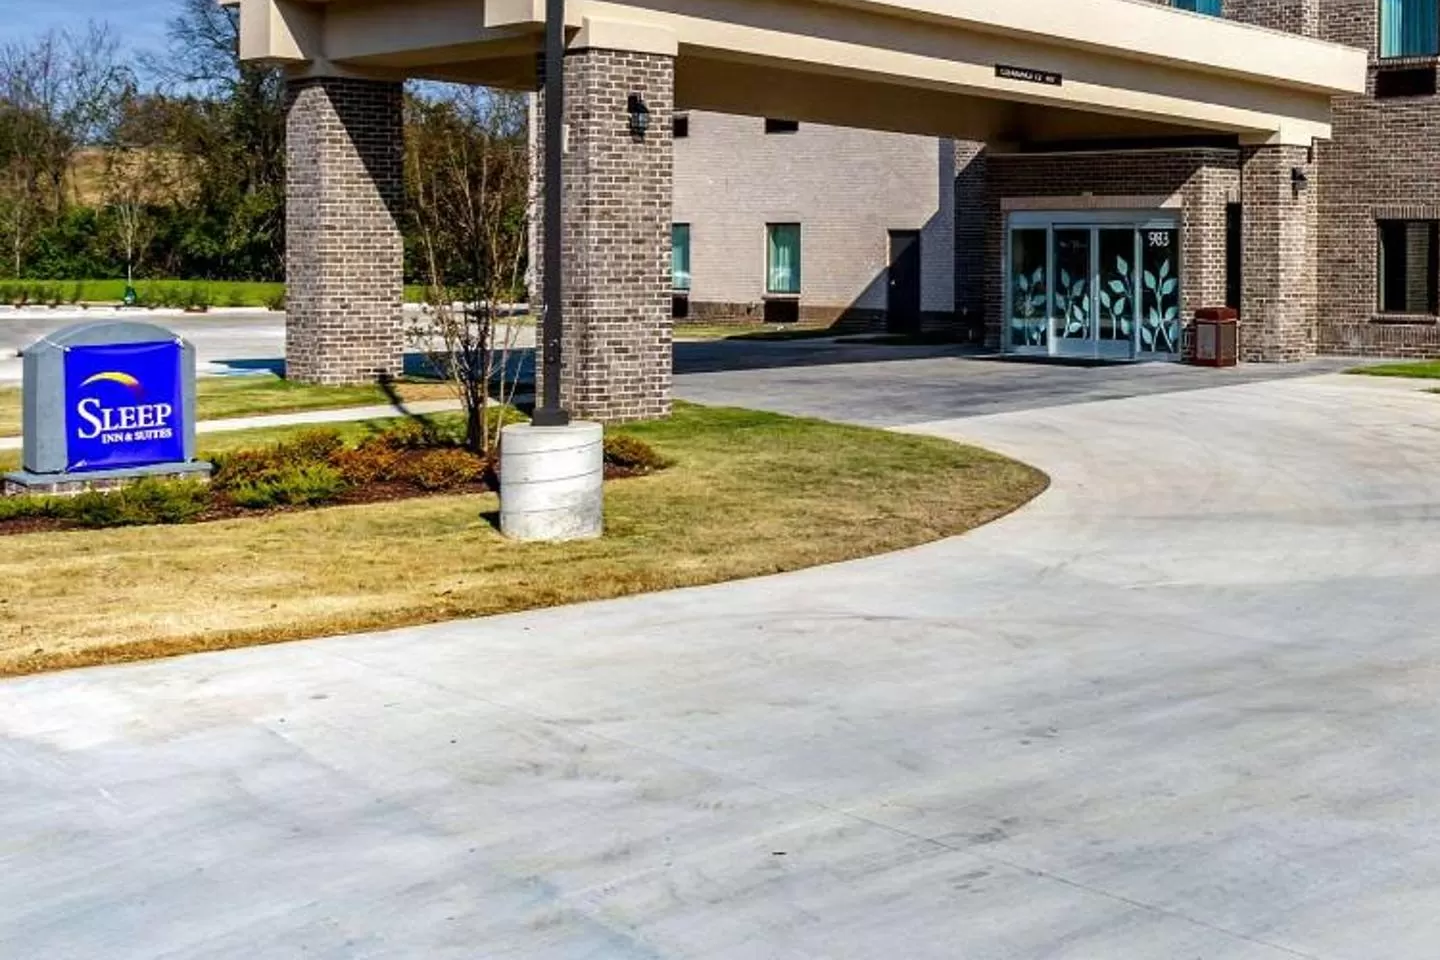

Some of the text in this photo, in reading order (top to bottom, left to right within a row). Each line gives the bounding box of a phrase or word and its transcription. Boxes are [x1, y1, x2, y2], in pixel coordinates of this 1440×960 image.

[77, 398, 172, 439] SLEEP
[102, 428, 172, 444] INN & SUITES
